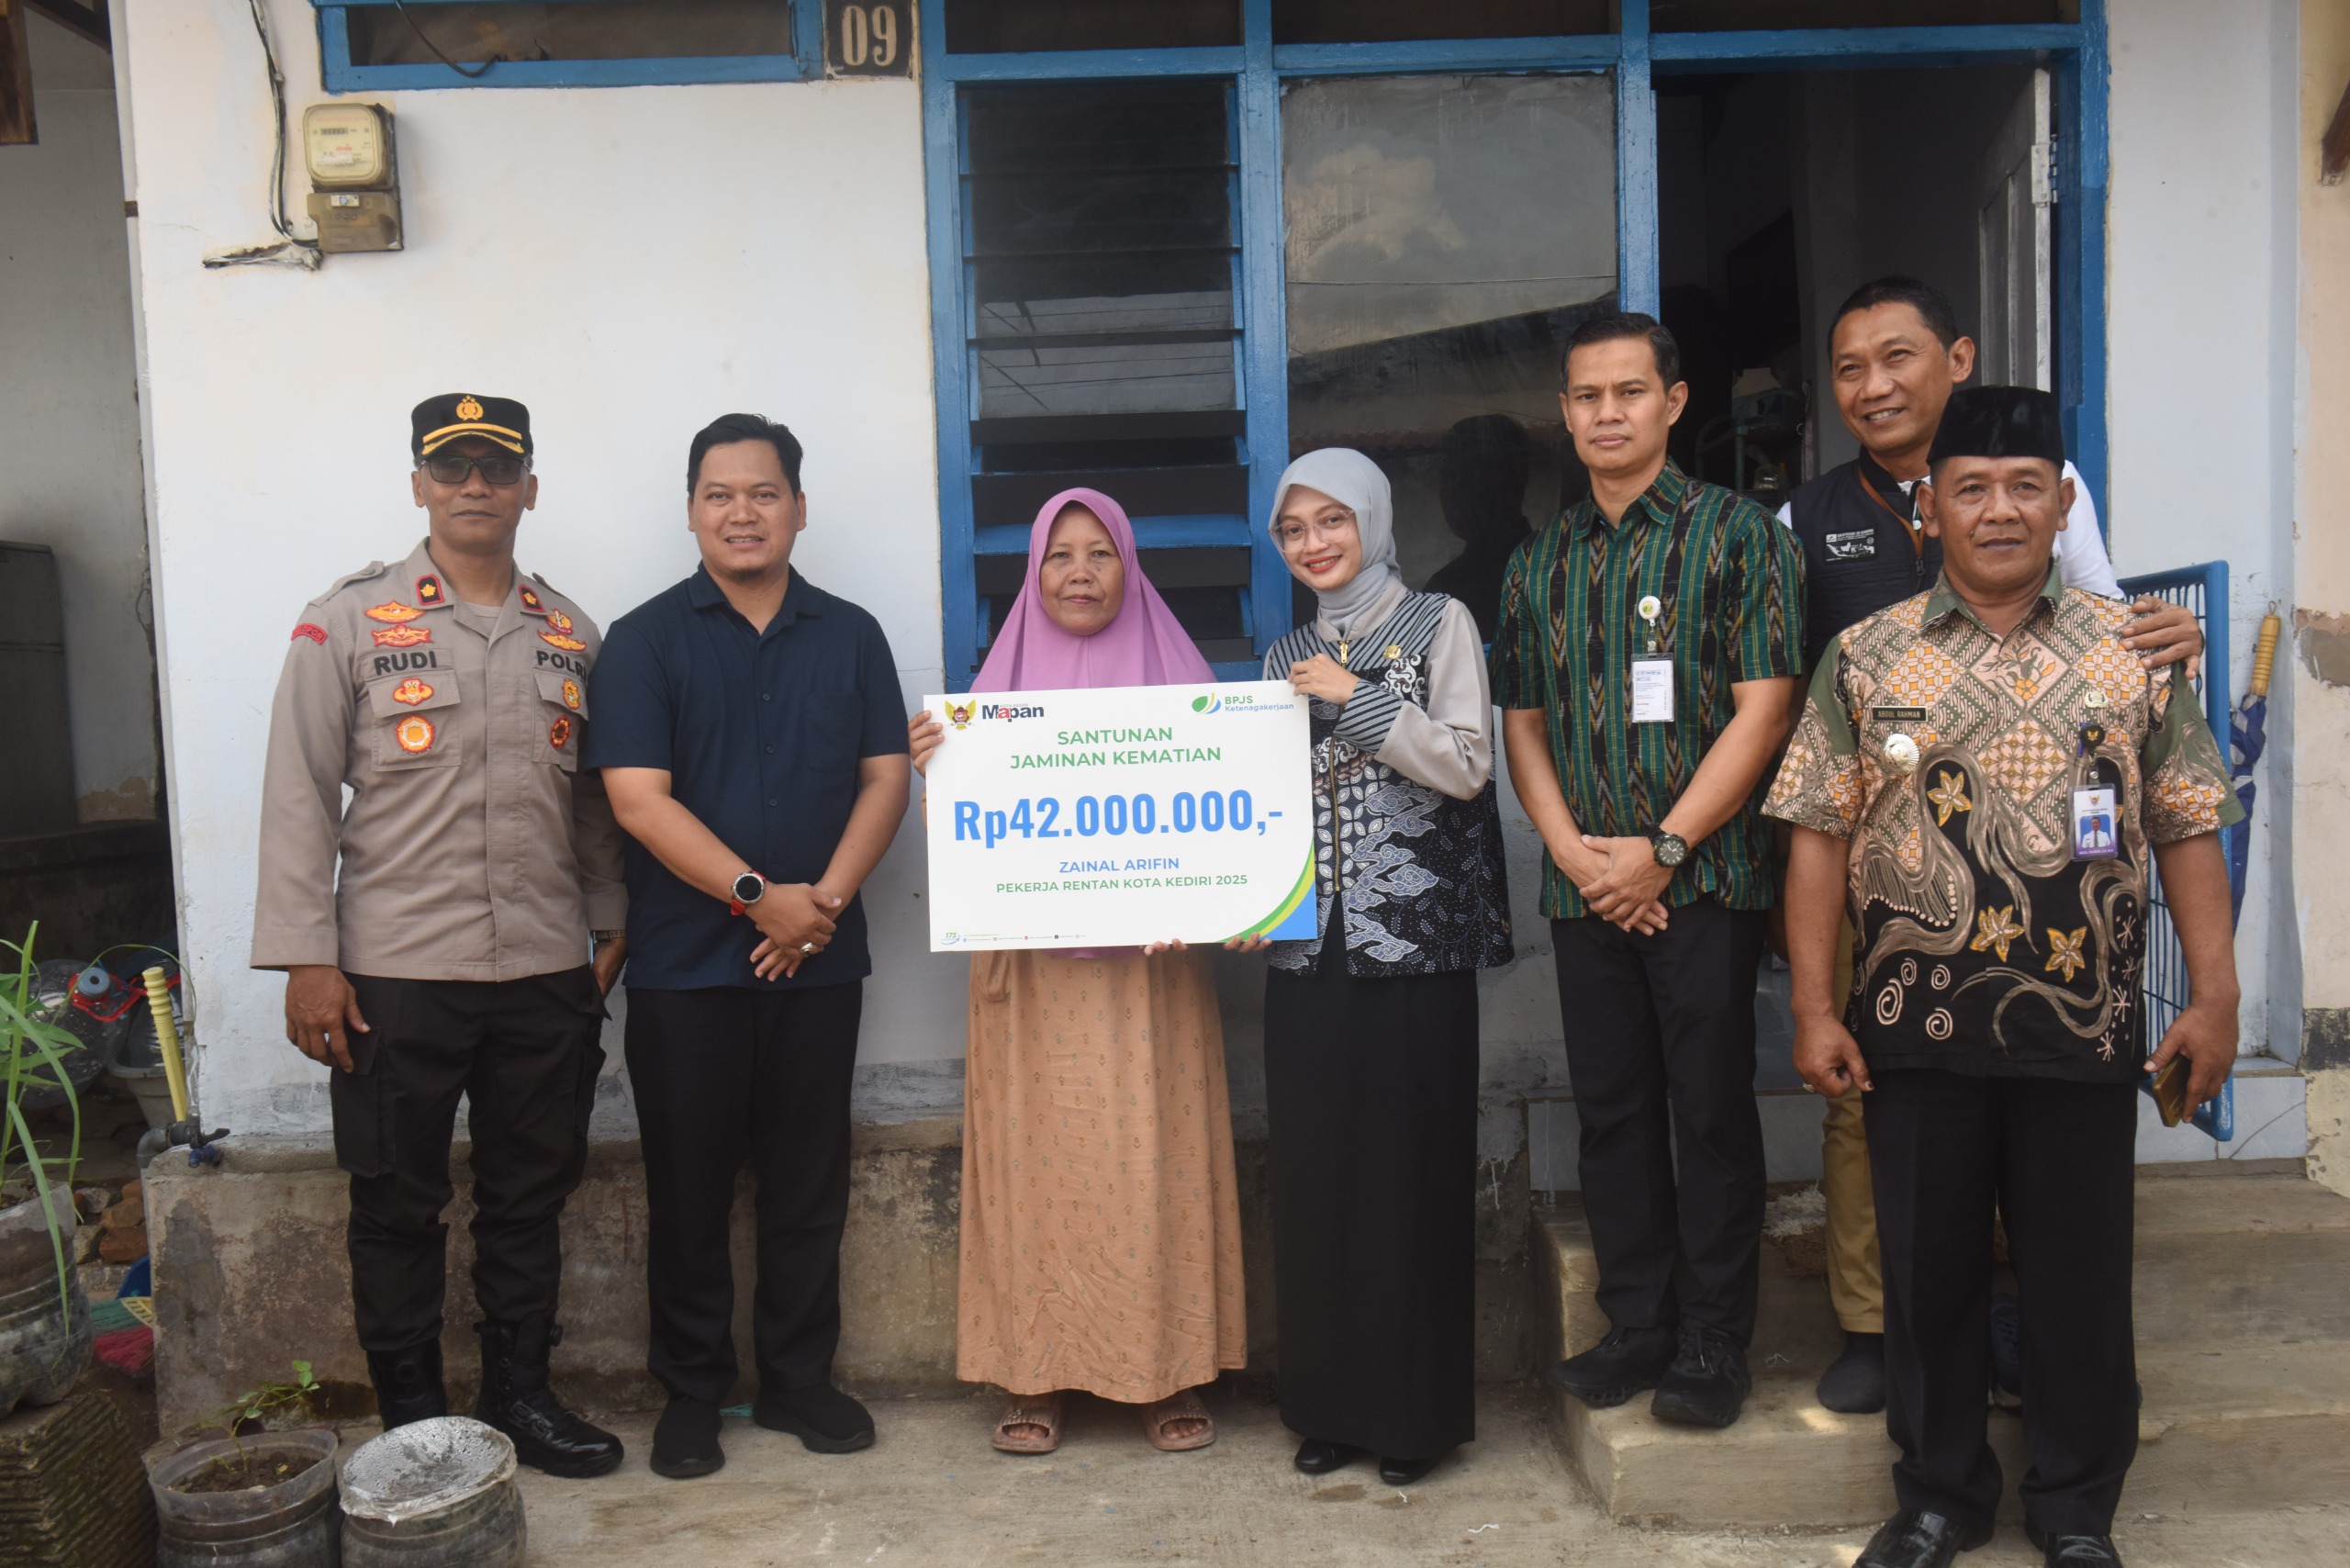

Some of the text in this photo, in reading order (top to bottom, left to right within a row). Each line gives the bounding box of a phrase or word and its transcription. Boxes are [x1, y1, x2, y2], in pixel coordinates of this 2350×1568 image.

[842, 6, 897, 67] 09
[374, 650, 437, 676] RUDI
[536, 650, 587, 682] POLRI
[1225, 695, 1253, 705] BPJS
[1225, 703, 1294, 712] Ketenagakerjaan
[981, 704, 1045, 722] Mapan
[1058, 727, 1173, 745] SANTUNAN
[1010, 746, 1221, 769] JAMINAN KEMATIAN
[954, 790, 1283, 849] Rp42.000.000,-
[1058, 857, 1180, 873] ZAINAL ARIFIN
[996, 874, 1248, 893] PEKERJA RENTAN KOTA KEDIRI 2025
